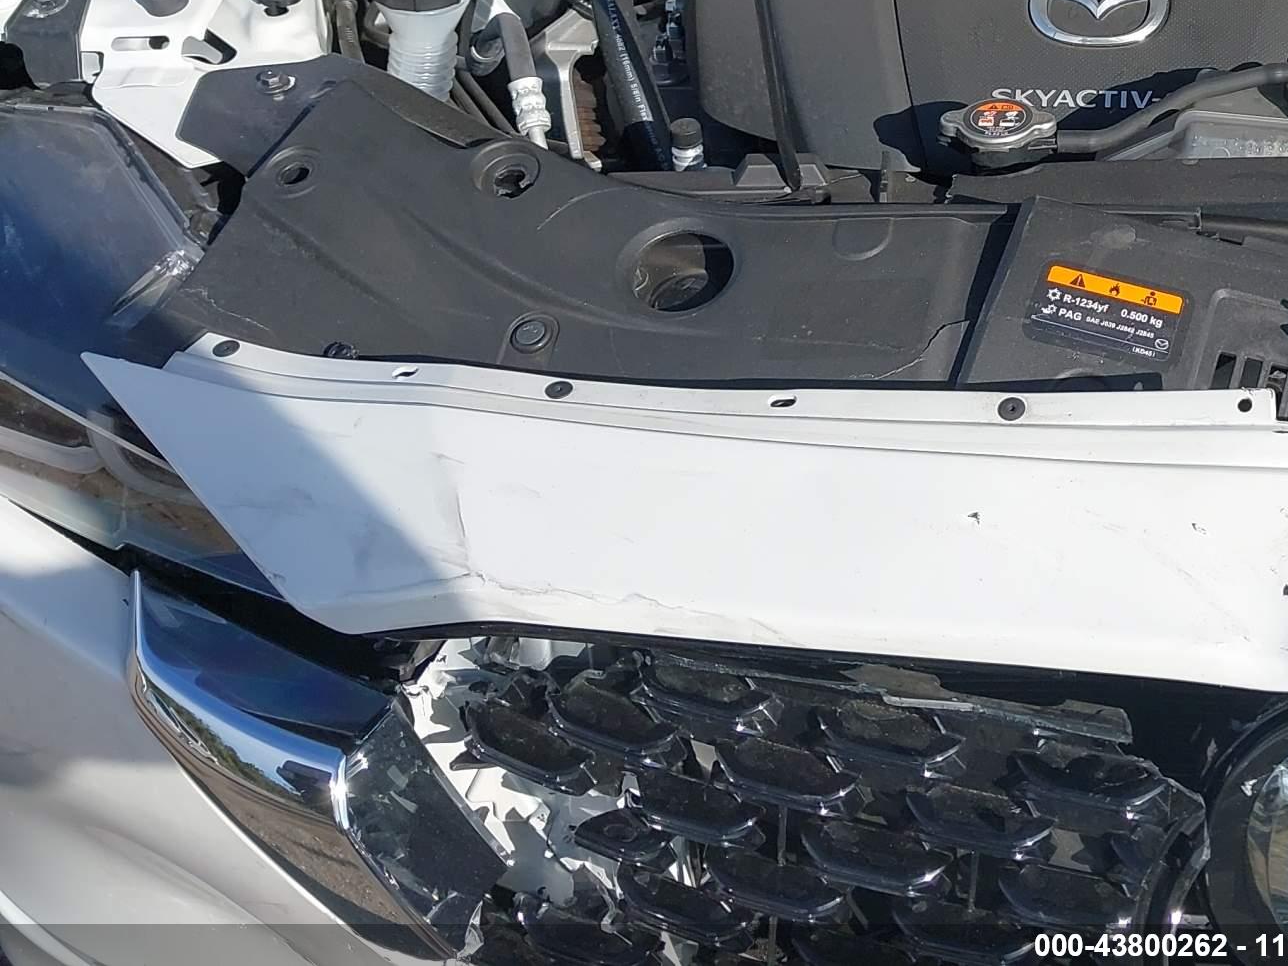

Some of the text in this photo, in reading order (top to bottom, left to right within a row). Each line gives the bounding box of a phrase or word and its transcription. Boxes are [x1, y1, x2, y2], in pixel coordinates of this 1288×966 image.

[1058, 307, 1082, 321] PAG
[1063, 293, 1163, 328] R-1234yf 0.500 kg
